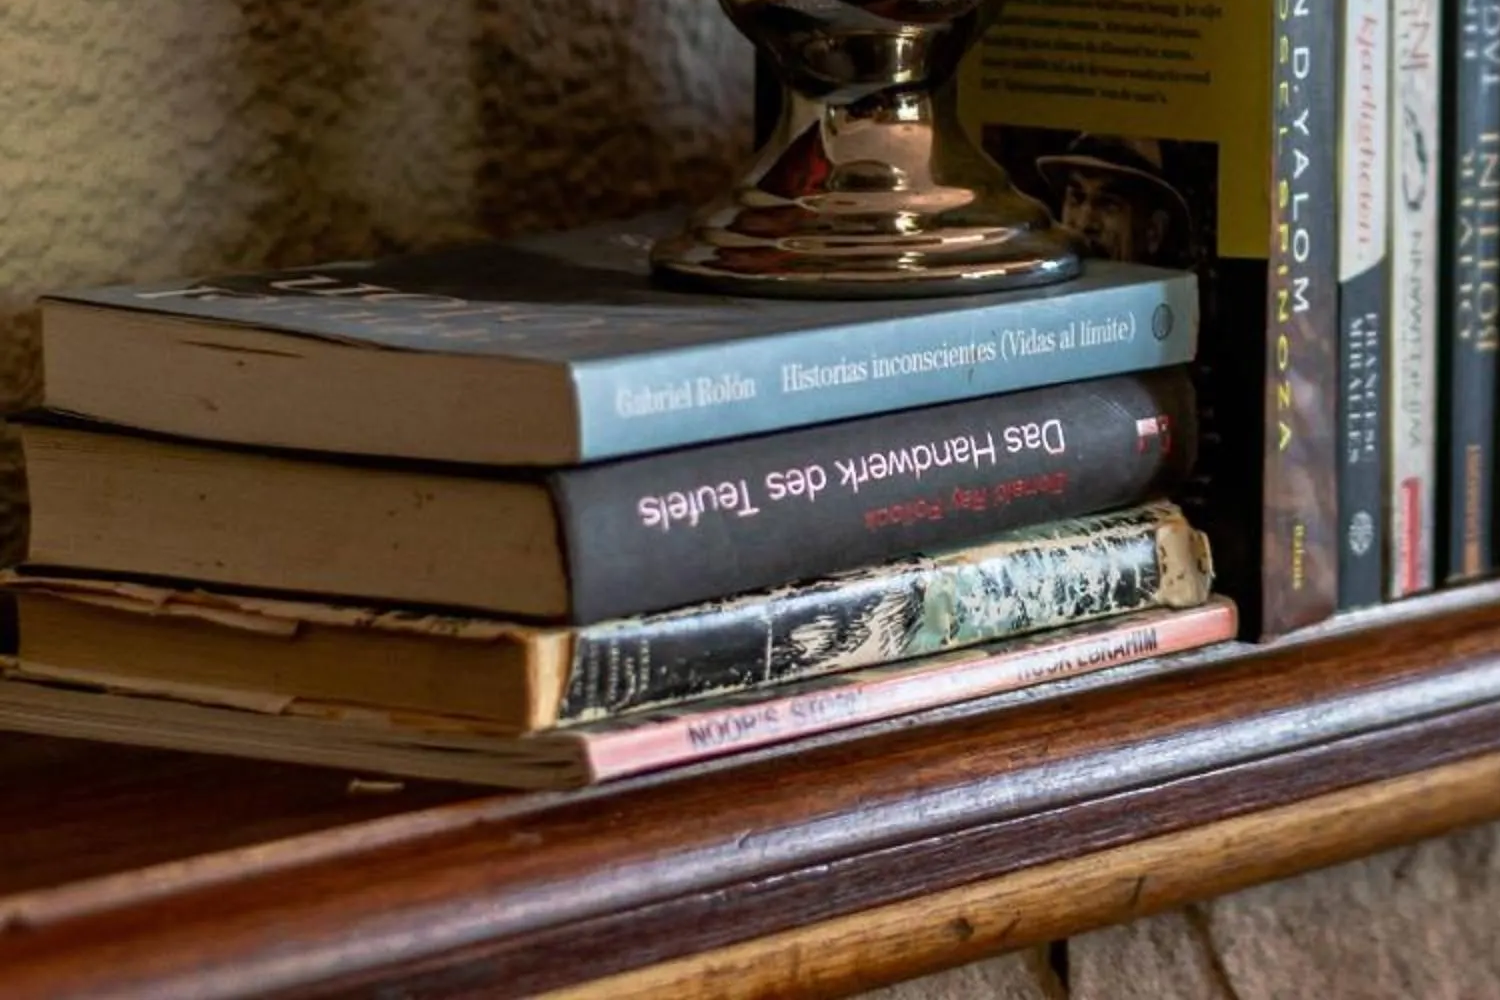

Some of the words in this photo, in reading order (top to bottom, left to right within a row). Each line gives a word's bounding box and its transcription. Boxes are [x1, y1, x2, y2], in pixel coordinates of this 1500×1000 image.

[1276, 182, 1292, 452] SPINOZA
[614, 379, 694, 420] Gabriel
[696, 371, 757, 408] Rolón
[781, 358, 868, 394] Historias
[871, 337, 997, 379] inconscientes
[999, 324, 1057, 363] (Vidas
[1058, 322, 1077, 350] al
[1078, 311, 1136, 346] límite)
[834, 427, 997, 487] Handwerk
[1003, 417, 1066, 456] Das
[637, 484, 760, 533] Teufels
[765, 466, 828, 501] des
